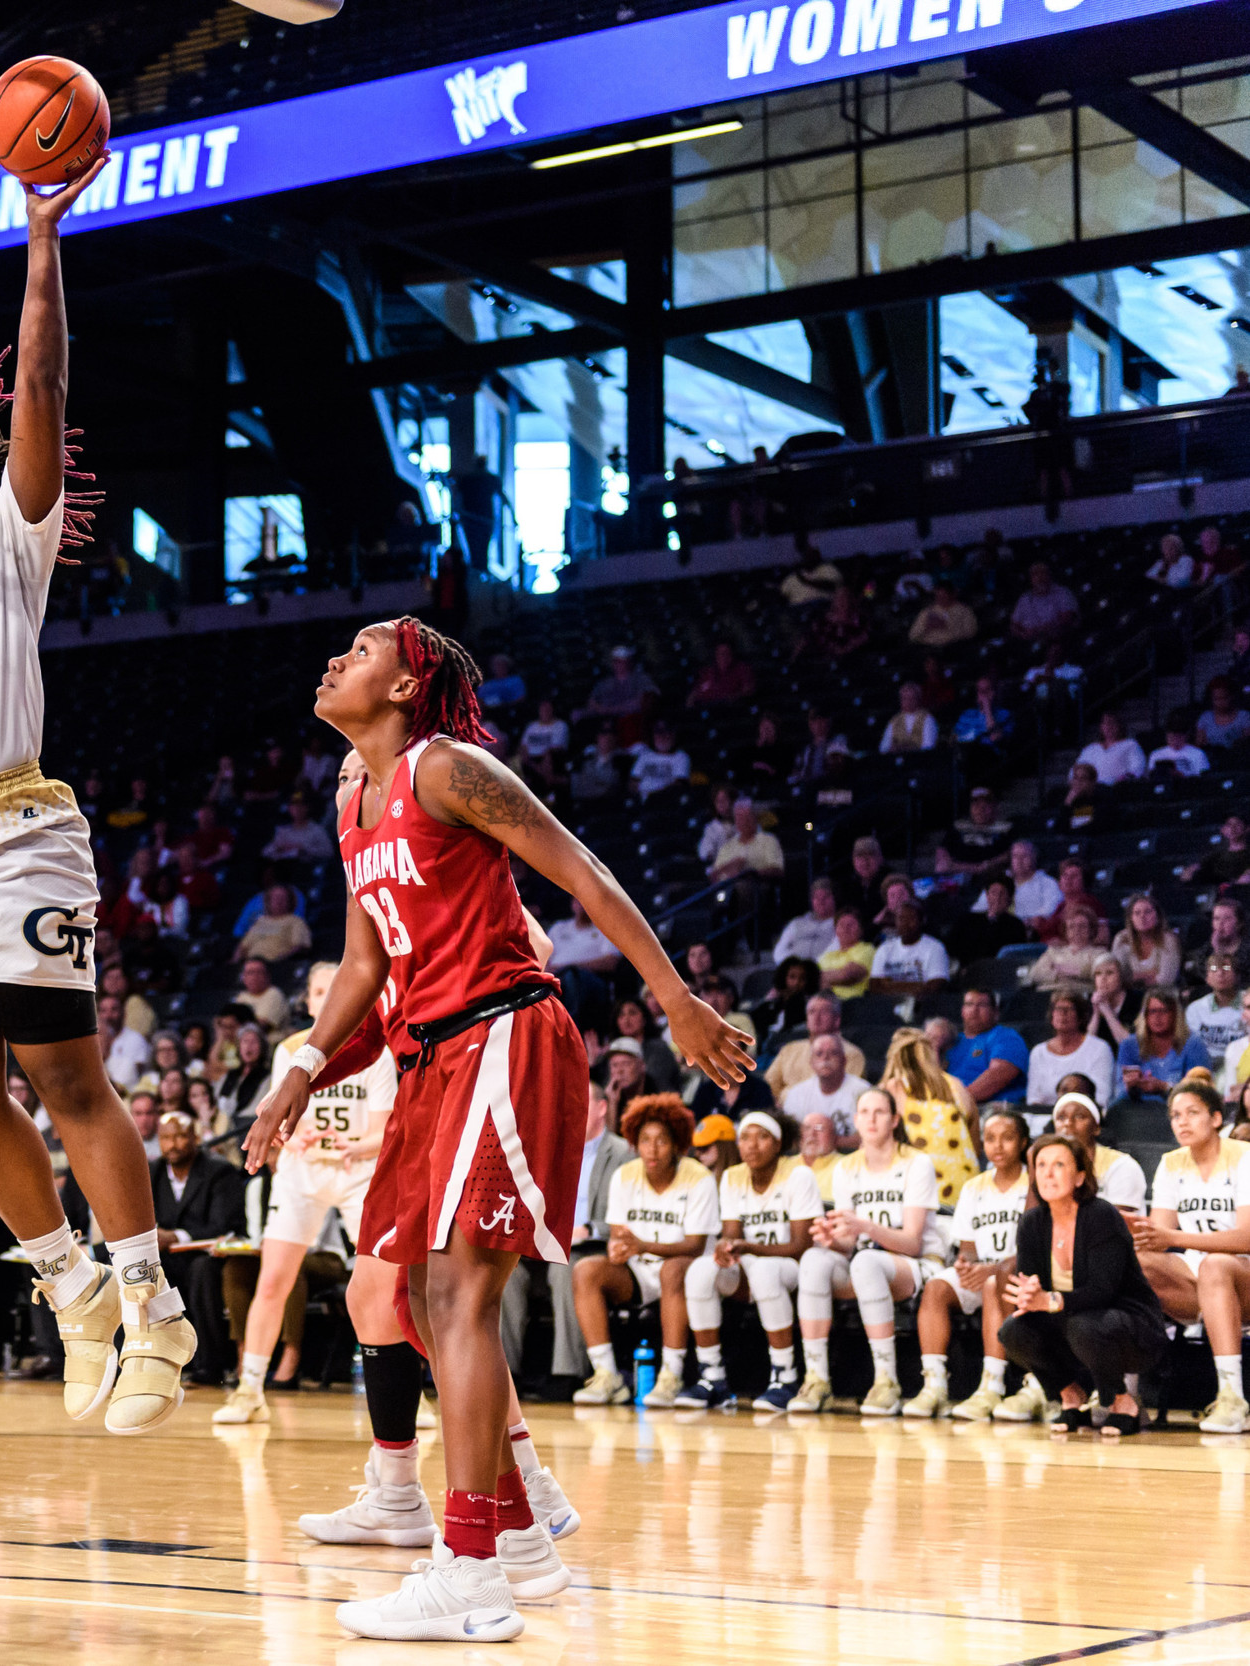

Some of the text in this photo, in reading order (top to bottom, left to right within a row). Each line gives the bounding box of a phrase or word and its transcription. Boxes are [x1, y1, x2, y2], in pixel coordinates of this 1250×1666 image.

[727, 0, 1084, 80] WOMEN
[22, 905, 94, 970] GT
[360, 887, 413, 958] 23
[315, 1107, 350, 1132] 55
[479, 1192, 516, 1235] A
